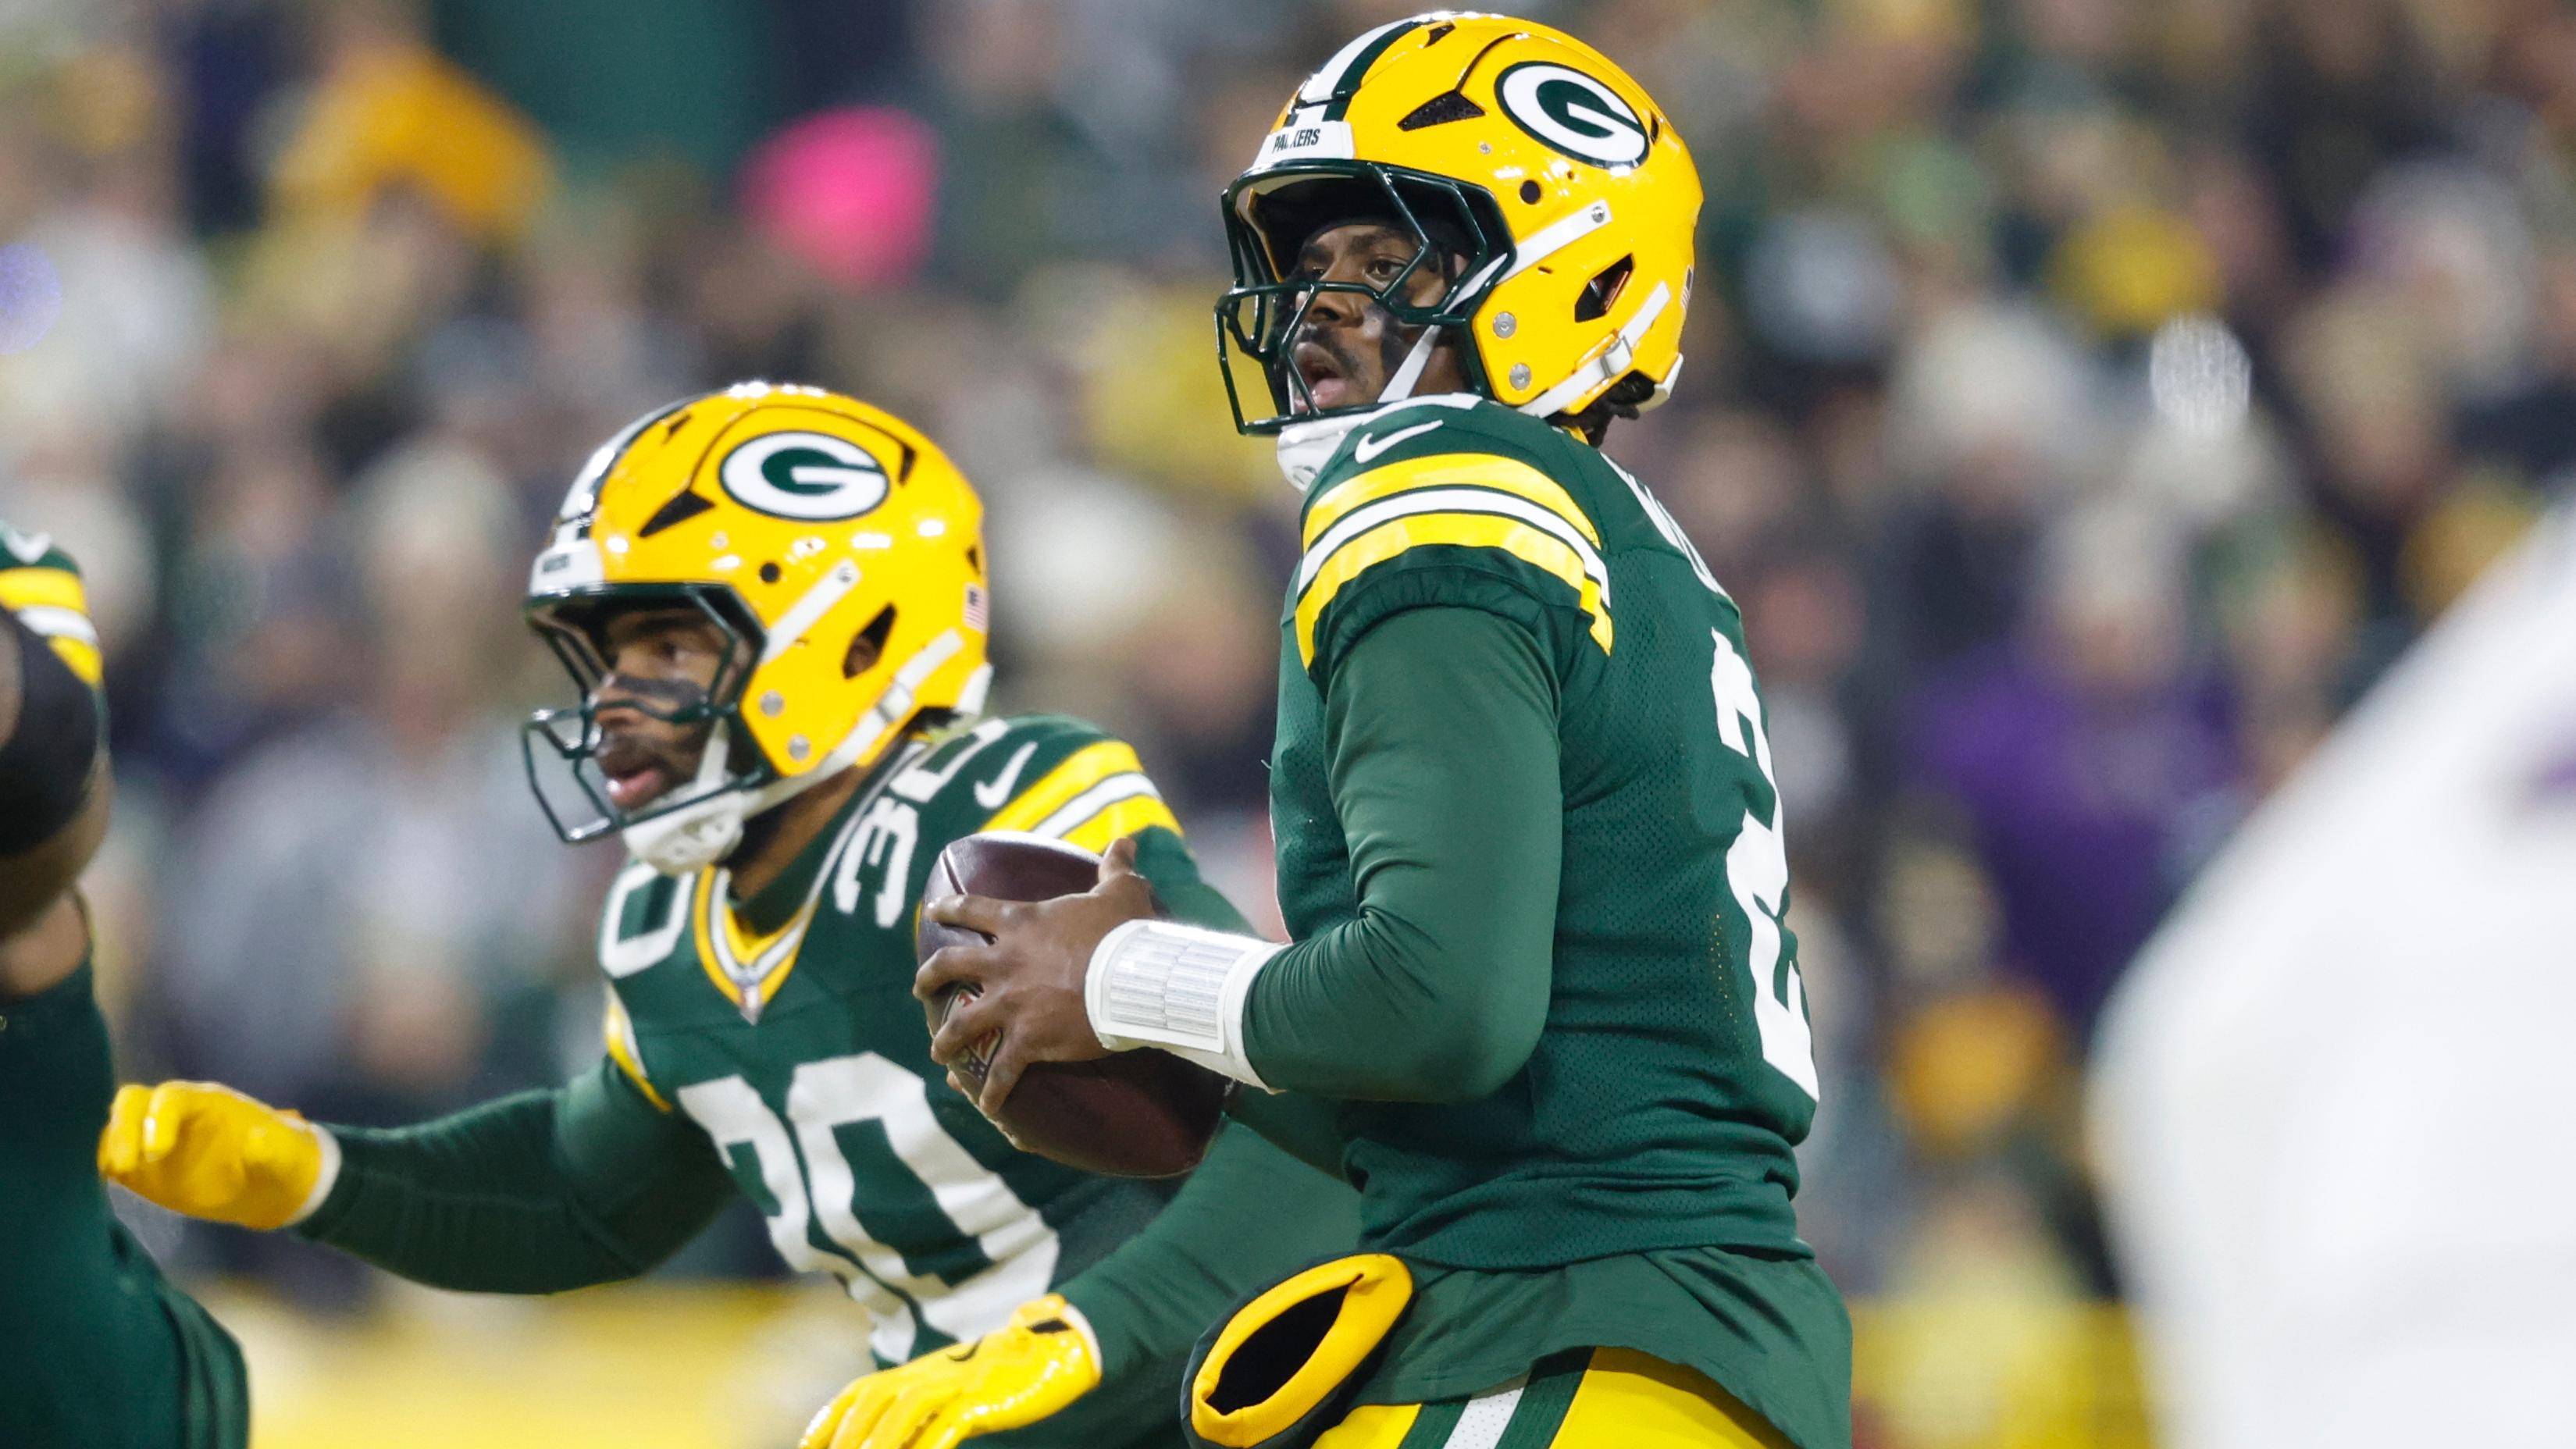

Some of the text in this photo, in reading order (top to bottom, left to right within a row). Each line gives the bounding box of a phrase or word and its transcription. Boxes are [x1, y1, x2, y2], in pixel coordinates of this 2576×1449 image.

[1494, 60, 1650, 169] G
[718, 429, 890, 523] G
[678, 1051, 1060, 1365] 30
